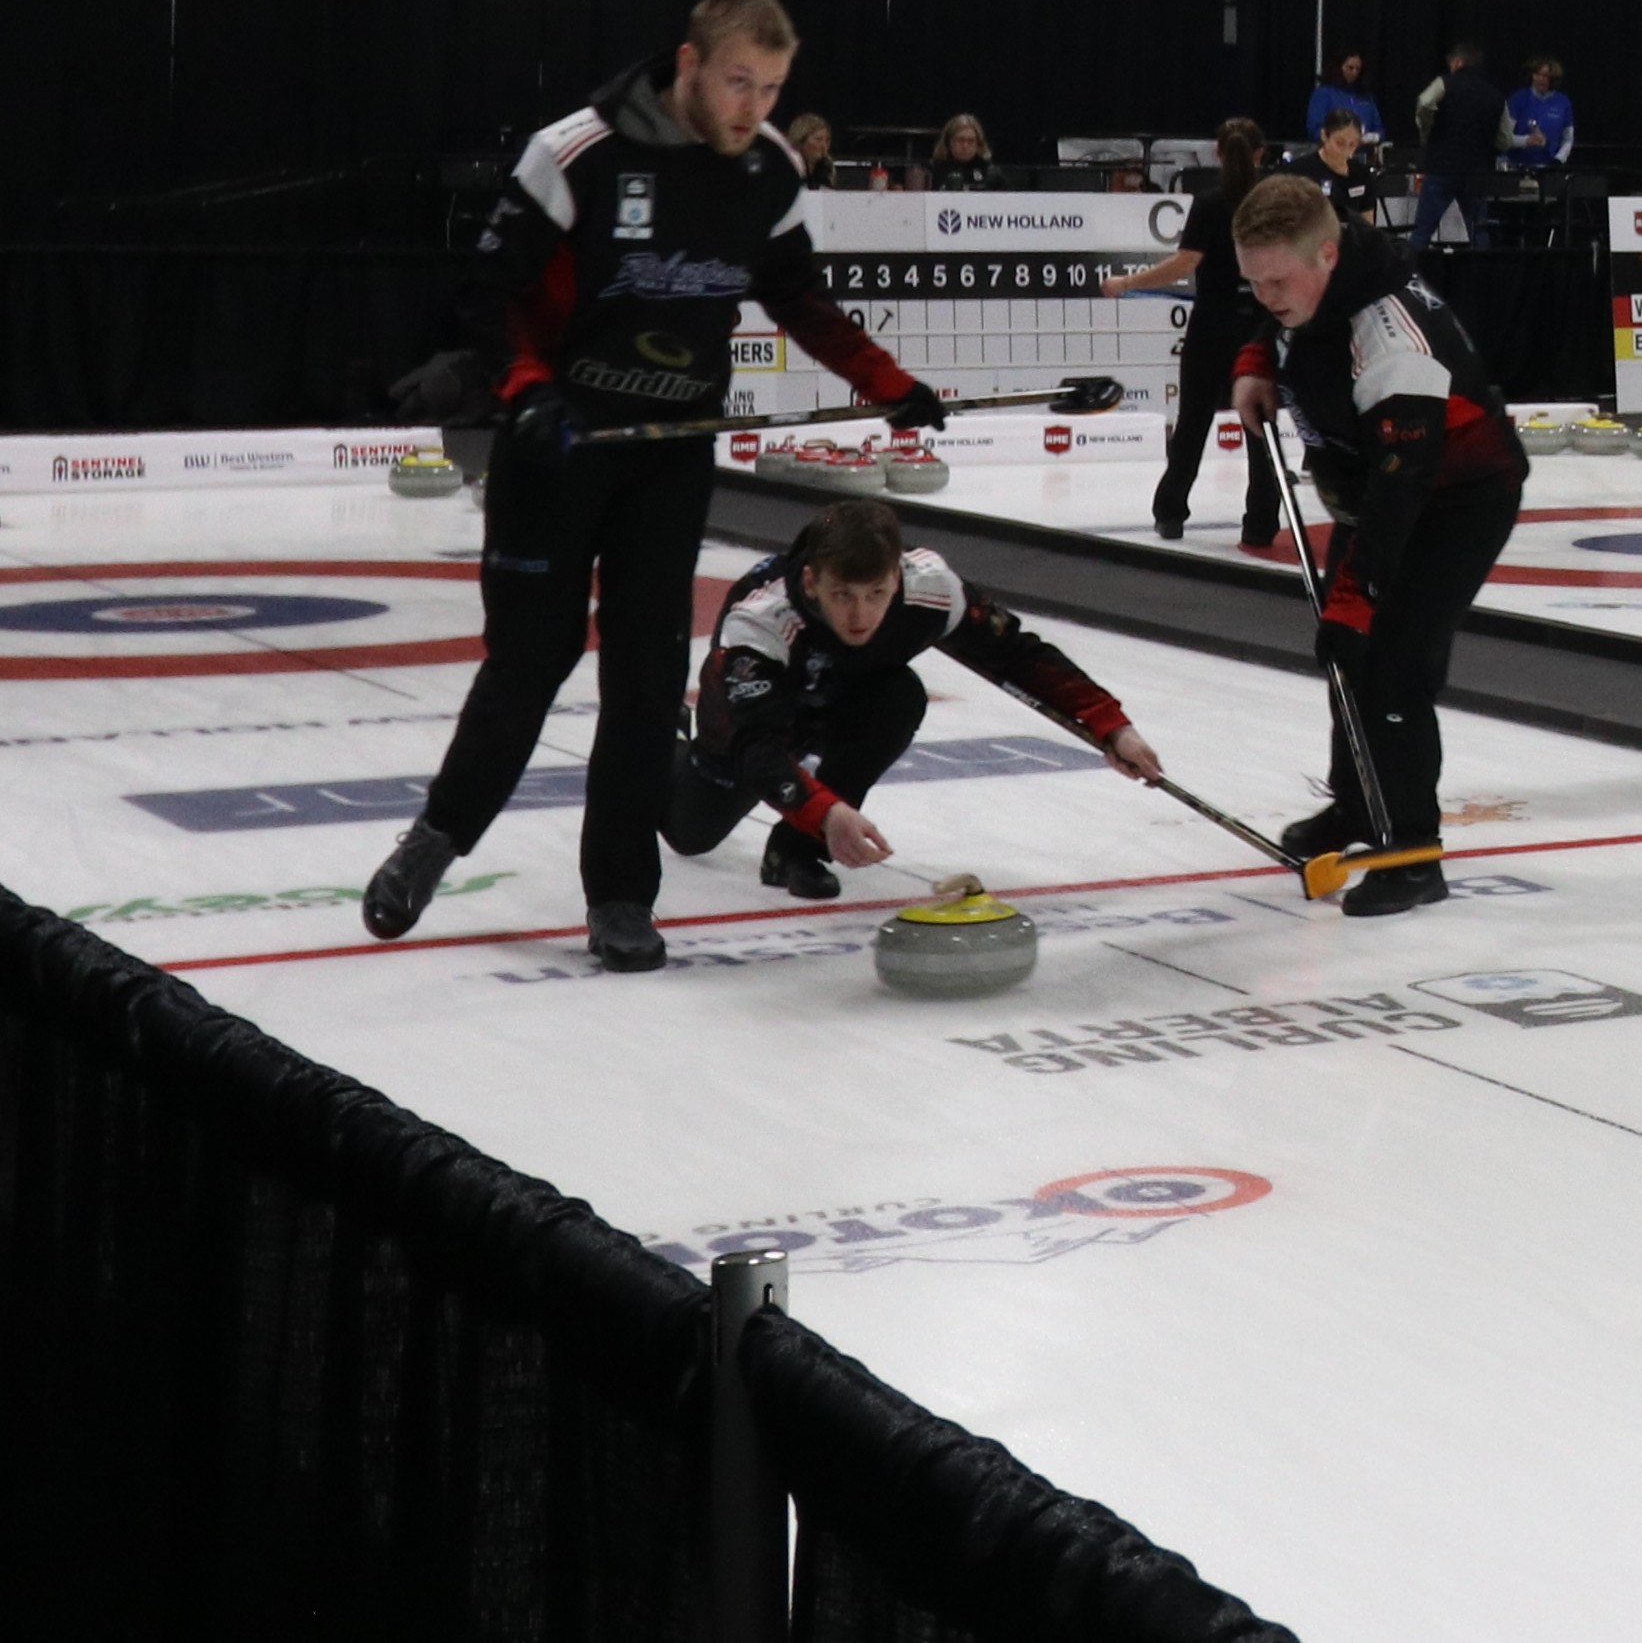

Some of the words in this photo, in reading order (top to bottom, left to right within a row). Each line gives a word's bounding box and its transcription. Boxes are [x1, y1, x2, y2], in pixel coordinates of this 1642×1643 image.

[967, 215, 1004, 229] NEW
[1007, 215, 1083, 229] HOLLAND
[1148, 199, 1186, 245] C
[822, 265, 834, 288] 1
[848, 265, 864, 288] 2
[877, 265, 891, 288] 3
[904, 265, 920, 288] 4
[933, 265, 948, 288] 5
[960, 264, 976, 288] 6
[987, 264, 1002, 287] 7
[1014, 264, 1030, 288] 8
[1042, 264, 1057, 287] 9
[1066, 265, 1086, 287] 10
[1095, 265, 1113, 286] 11
[1170, 305, 1188, 329] 0
[71, 456, 146, 469] SENTINEL
[184, 454, 211, 468] BW
[220, 454, 247, 464] Best
[248, 451, 294, 463] Western
[351, 456, 402, 468] STORA
[71, 468, 146, 481] STORAGE
[945, 992, 1407, 1055] ALBERTA
[1002, 1010, 1463, 1076] CURLING
